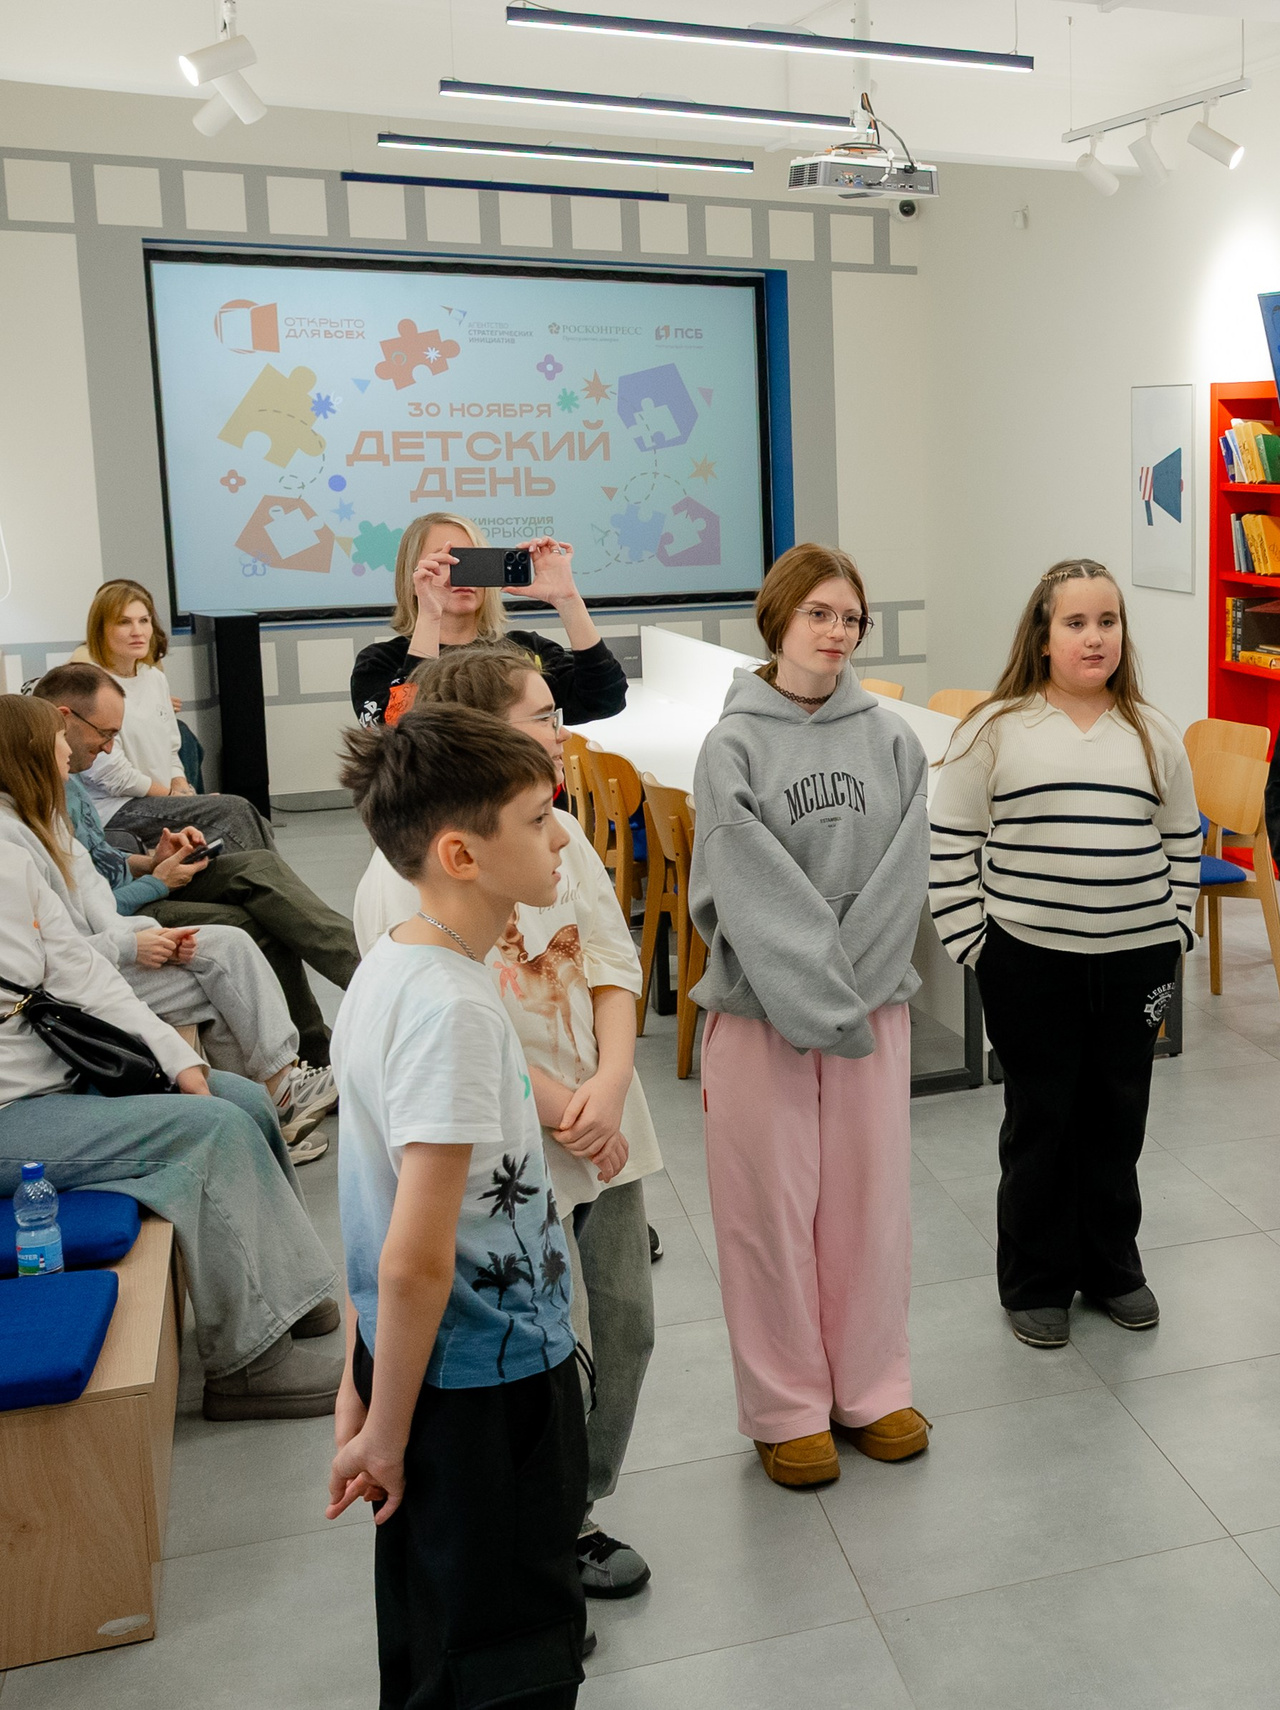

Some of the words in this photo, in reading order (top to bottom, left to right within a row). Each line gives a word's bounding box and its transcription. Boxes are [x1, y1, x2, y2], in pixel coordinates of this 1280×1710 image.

[284, 317, 365, 329] ОТКРЫТО
[285, 329, 321, 340] ДЛЯ
[323, 329, 366, 340] ВСЕХ
[468, 329, 533, 338] СТРАТЕГИЧЕСКИХ
[562, 324, 642, 336] РОСКОНГРЕСС
[674, 328, 703, 340] ПСБ
[408, 402, 441, 418] 30
[450, 402, 552, 418] НОЯБРЯ
[345, 419, 611, 467] ДЕТСКИЙ
[410, 467, 556, 503] ДЕНЬ
[481, 526, 555, 539] ОРЬКОГО
[784, 771, 866, 826] MCLLCTN
